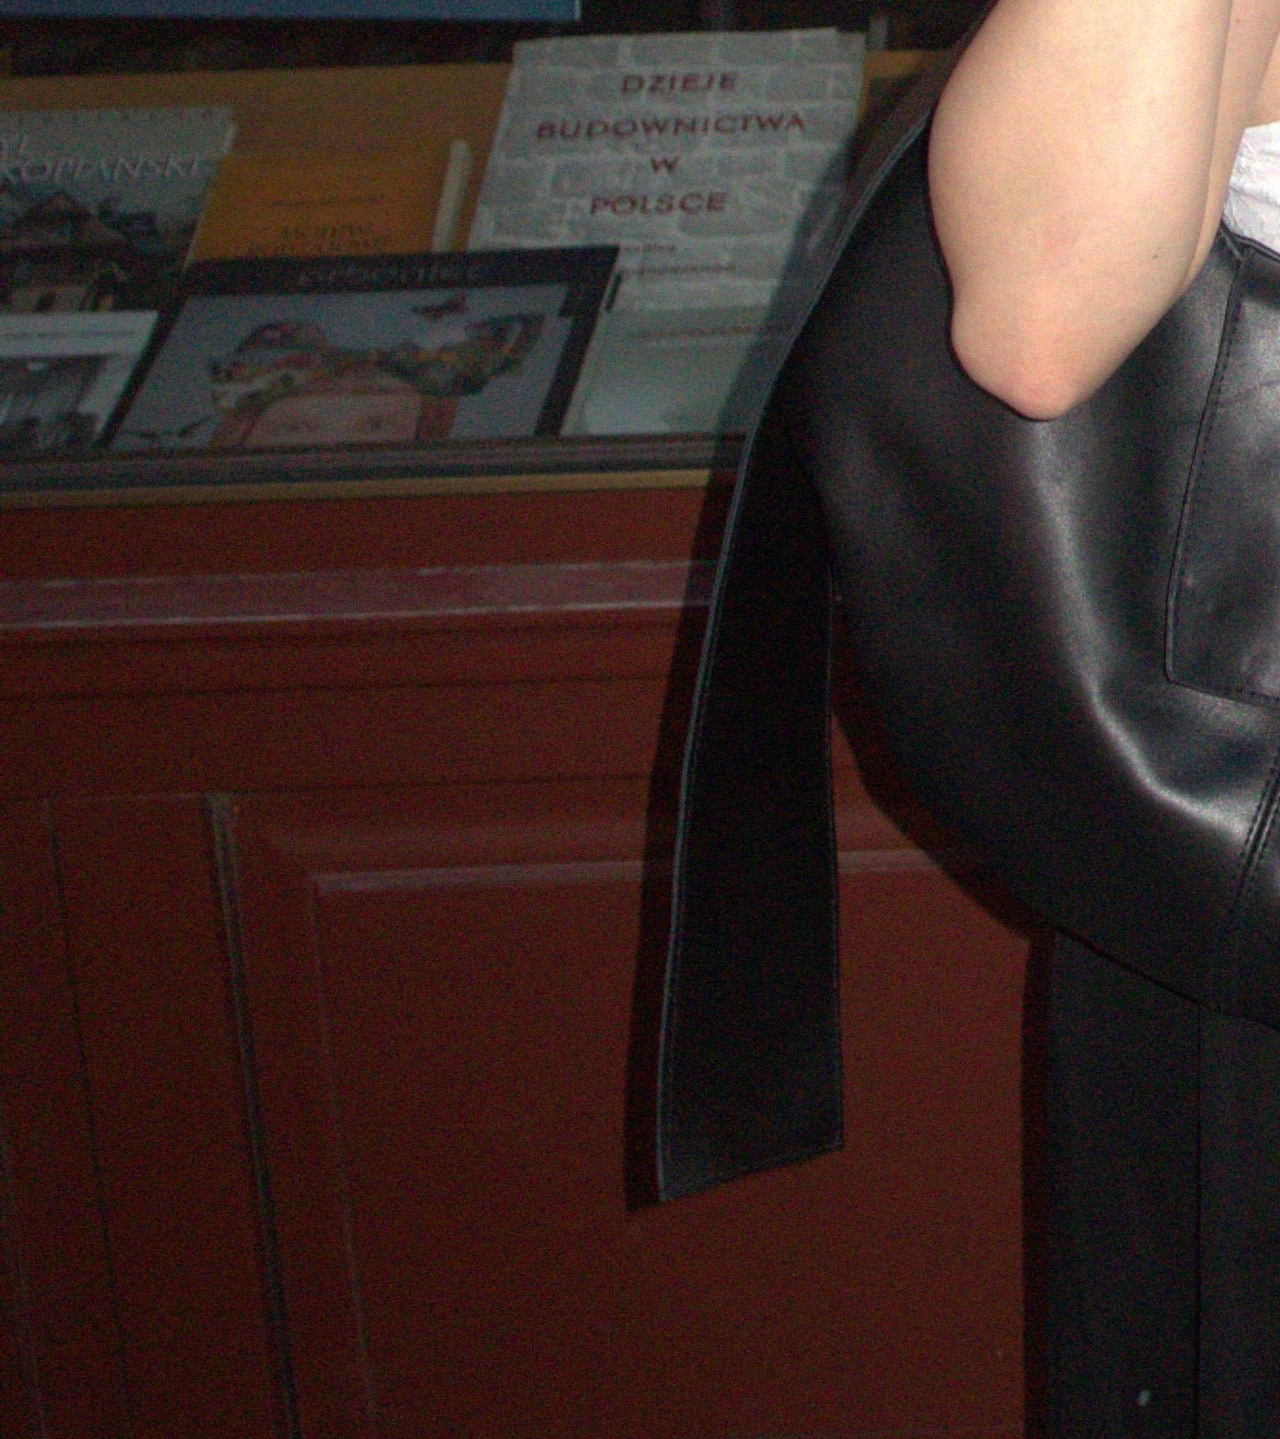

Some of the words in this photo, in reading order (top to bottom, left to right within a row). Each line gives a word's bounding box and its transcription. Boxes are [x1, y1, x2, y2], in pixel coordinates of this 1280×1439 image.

[620, 71, 738, 96] DZIEJE
[535, 111, 807, 142] BUDOWNICTWA
[650, 156, 680, 173] W
[590, 191, 728, 216] POLSCE
